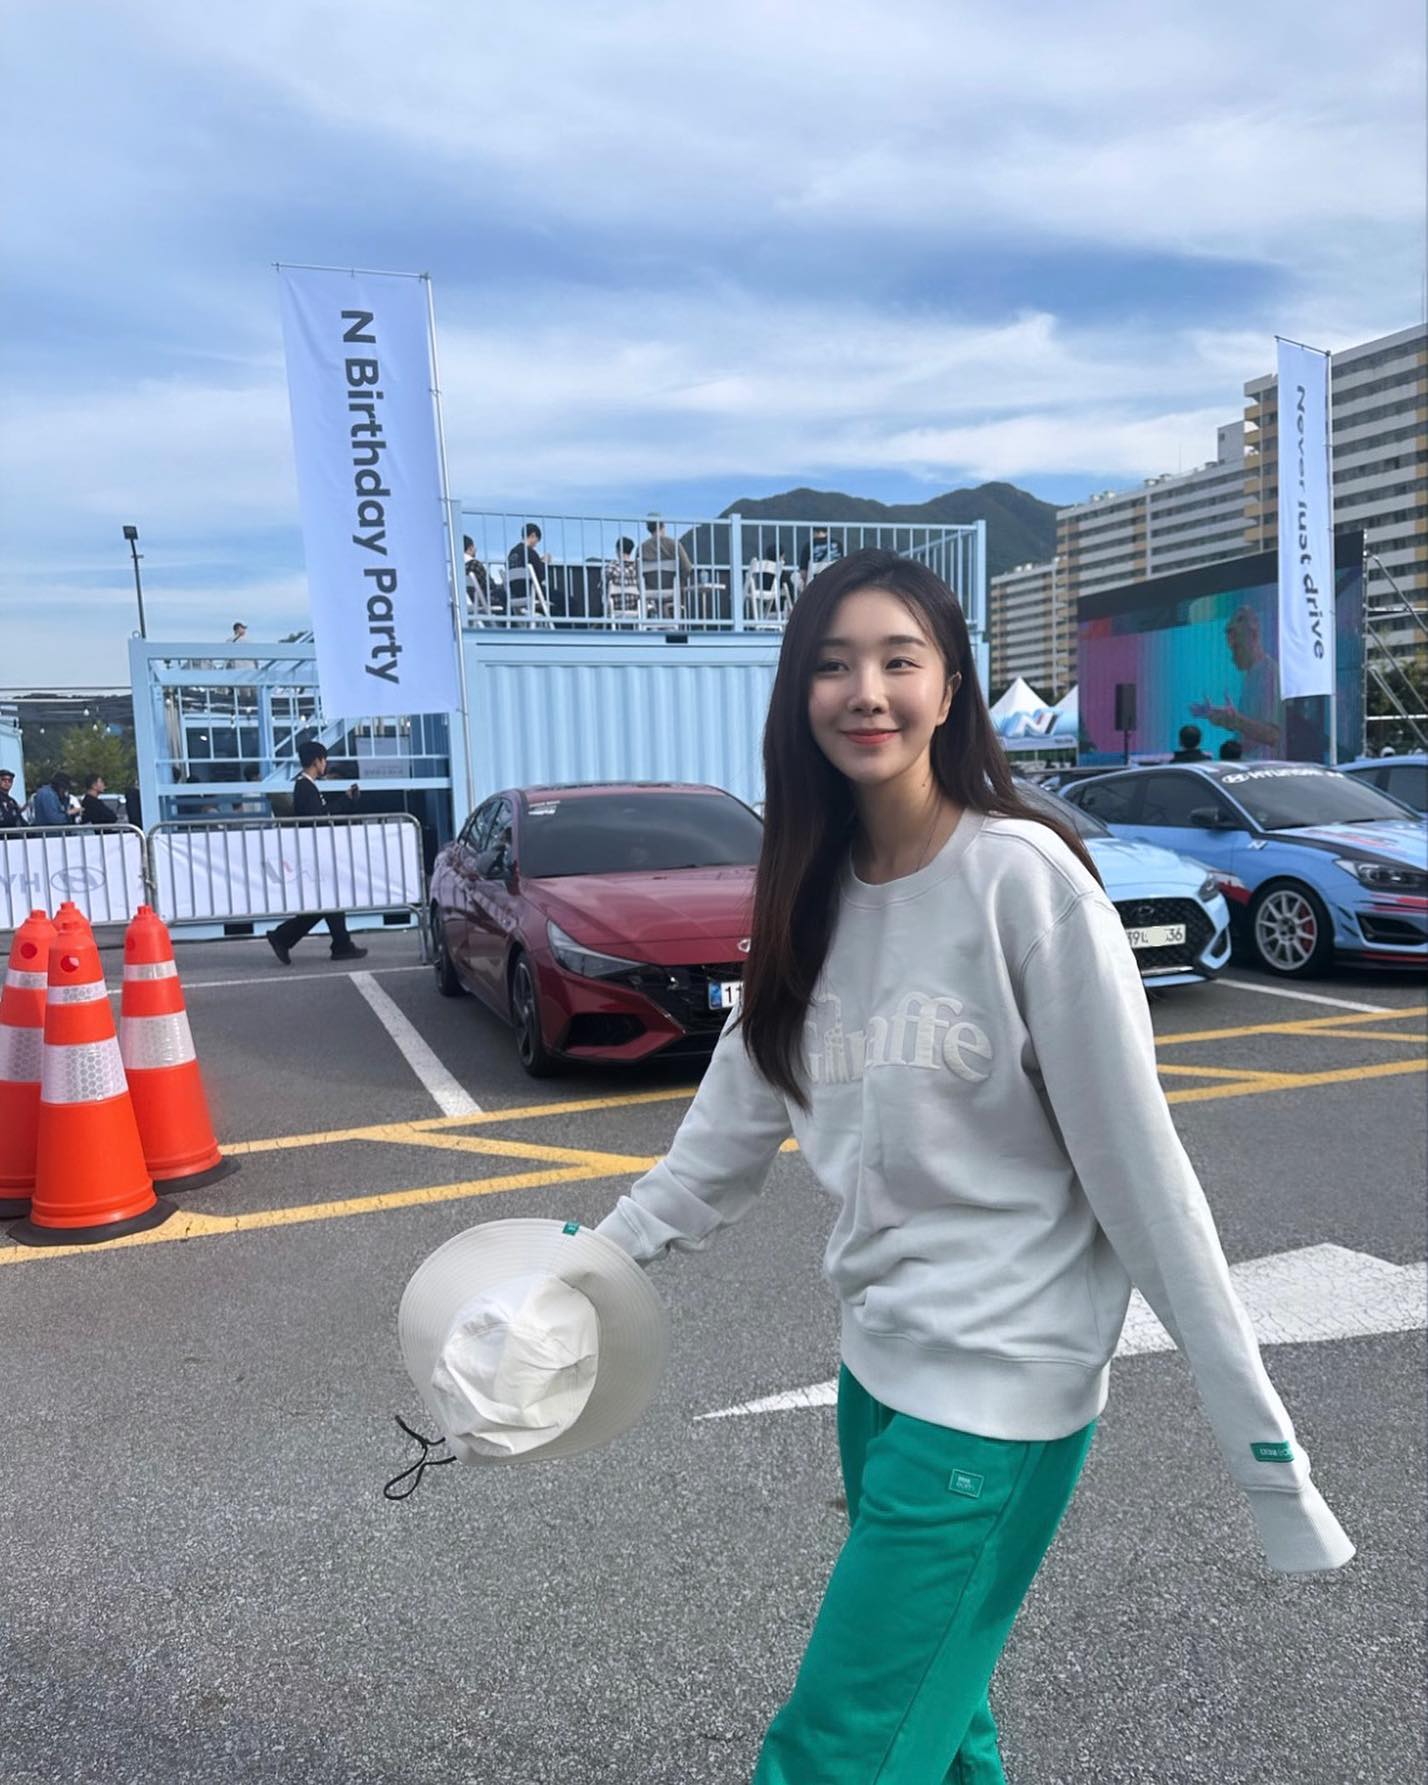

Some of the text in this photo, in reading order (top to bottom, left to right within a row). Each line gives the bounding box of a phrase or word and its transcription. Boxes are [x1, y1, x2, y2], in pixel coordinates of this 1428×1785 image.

[341, 310, 403, 684] N Birthday Party
[1302, 573, 1324, 659] drive
